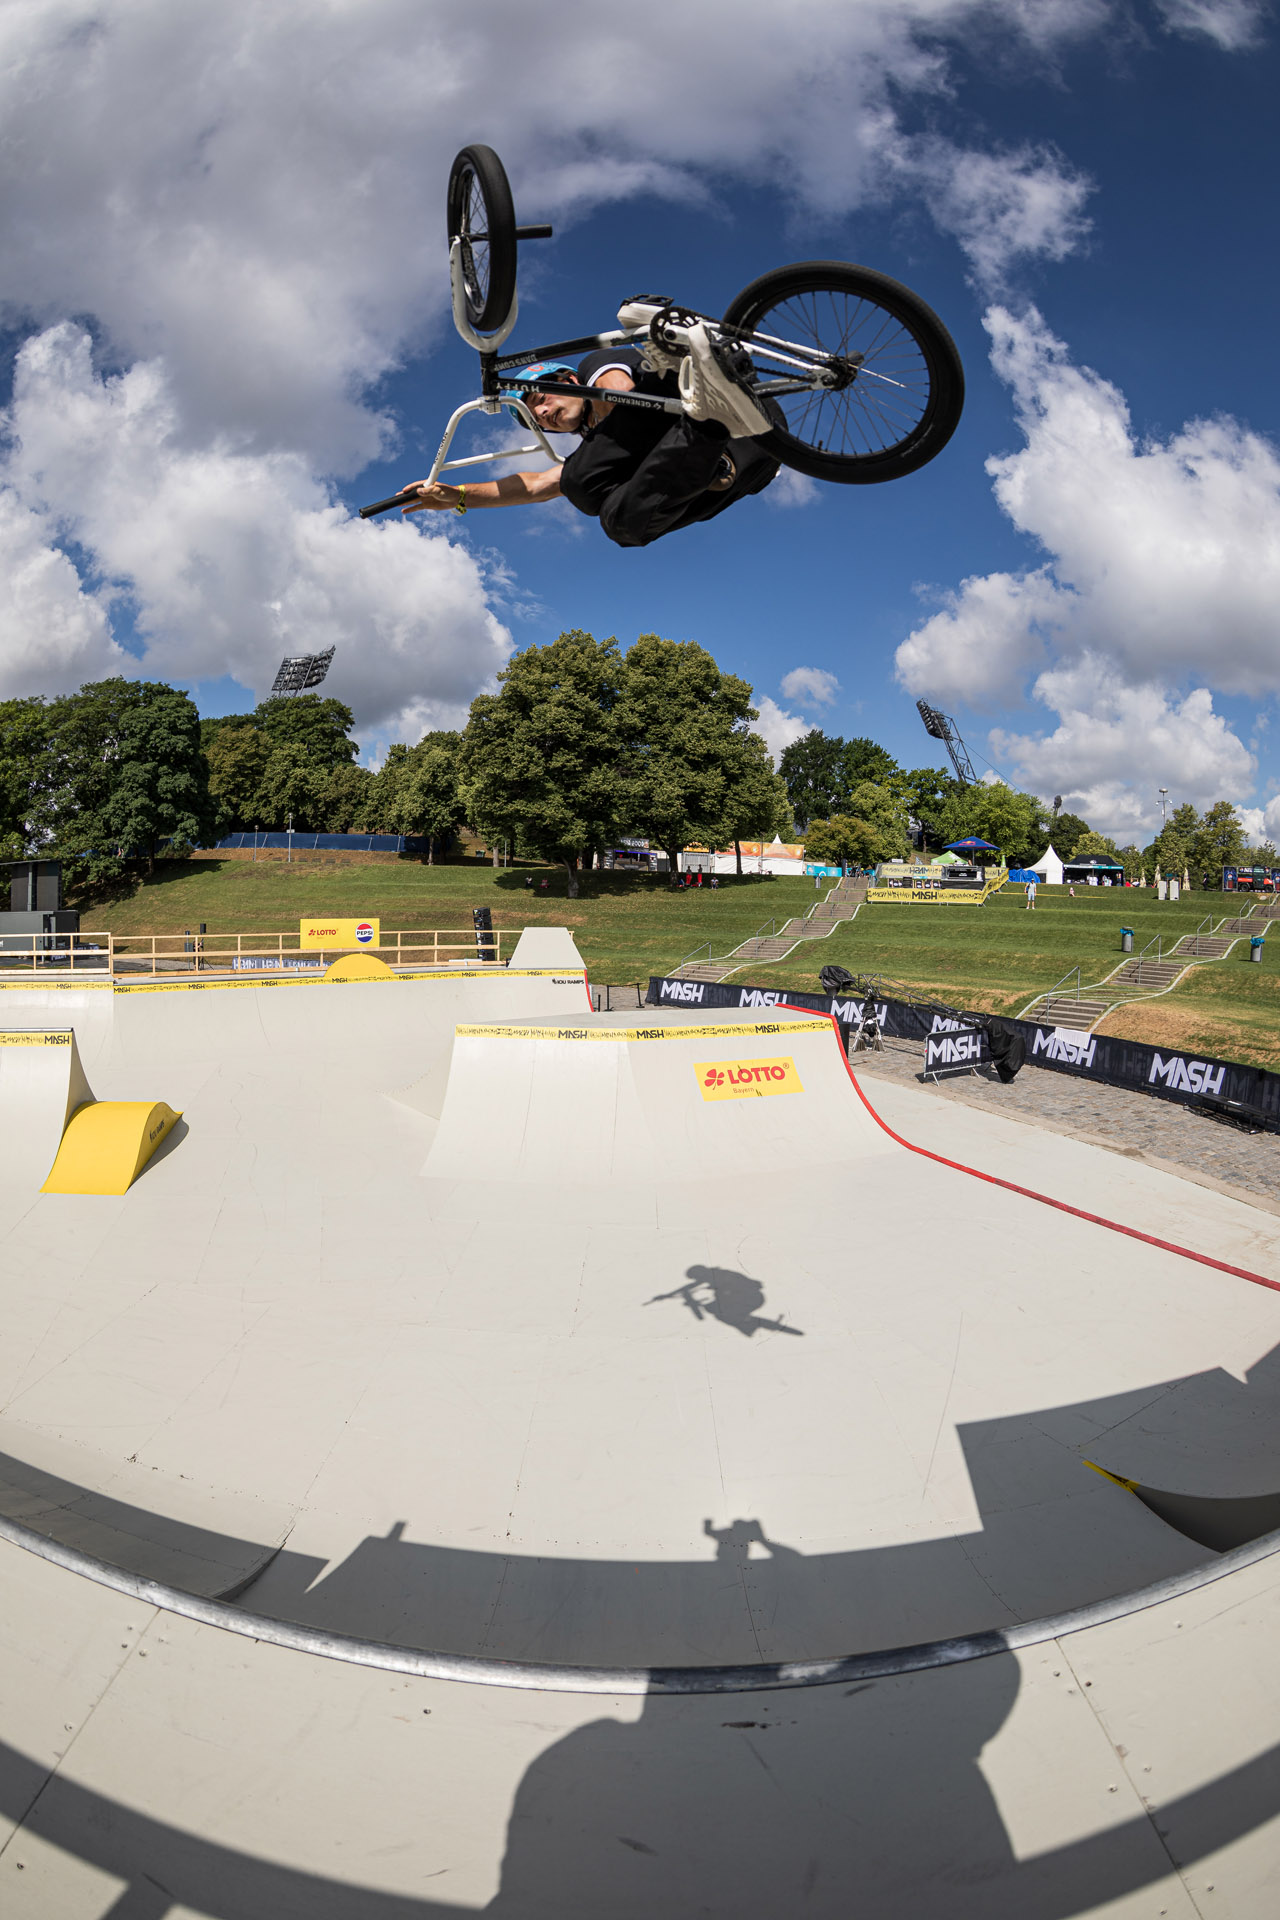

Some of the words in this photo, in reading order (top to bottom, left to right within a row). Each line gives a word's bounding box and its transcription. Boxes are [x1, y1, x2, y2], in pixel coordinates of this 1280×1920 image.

[496, 382, 540, 393] HUFFY
[607, 394, 651, 408] GENERATOR
[911, 891, 937, 899] MASH
[558, 1029, 588, 1040] MASH
[636, 1029, 665, 1039] MASH
[755, 1024, 780, 1034] MASH
[660, 980, 705, 1003] MASH
[1149, 1052, 1226, 1095] MASH
[44, 1035, 70, 1045] MASH
[927, 1034, 982, 1066] MASH
[727, 1065, 786, 1085] LOTTO
[732, 1086, 755, 1094] Bayern
